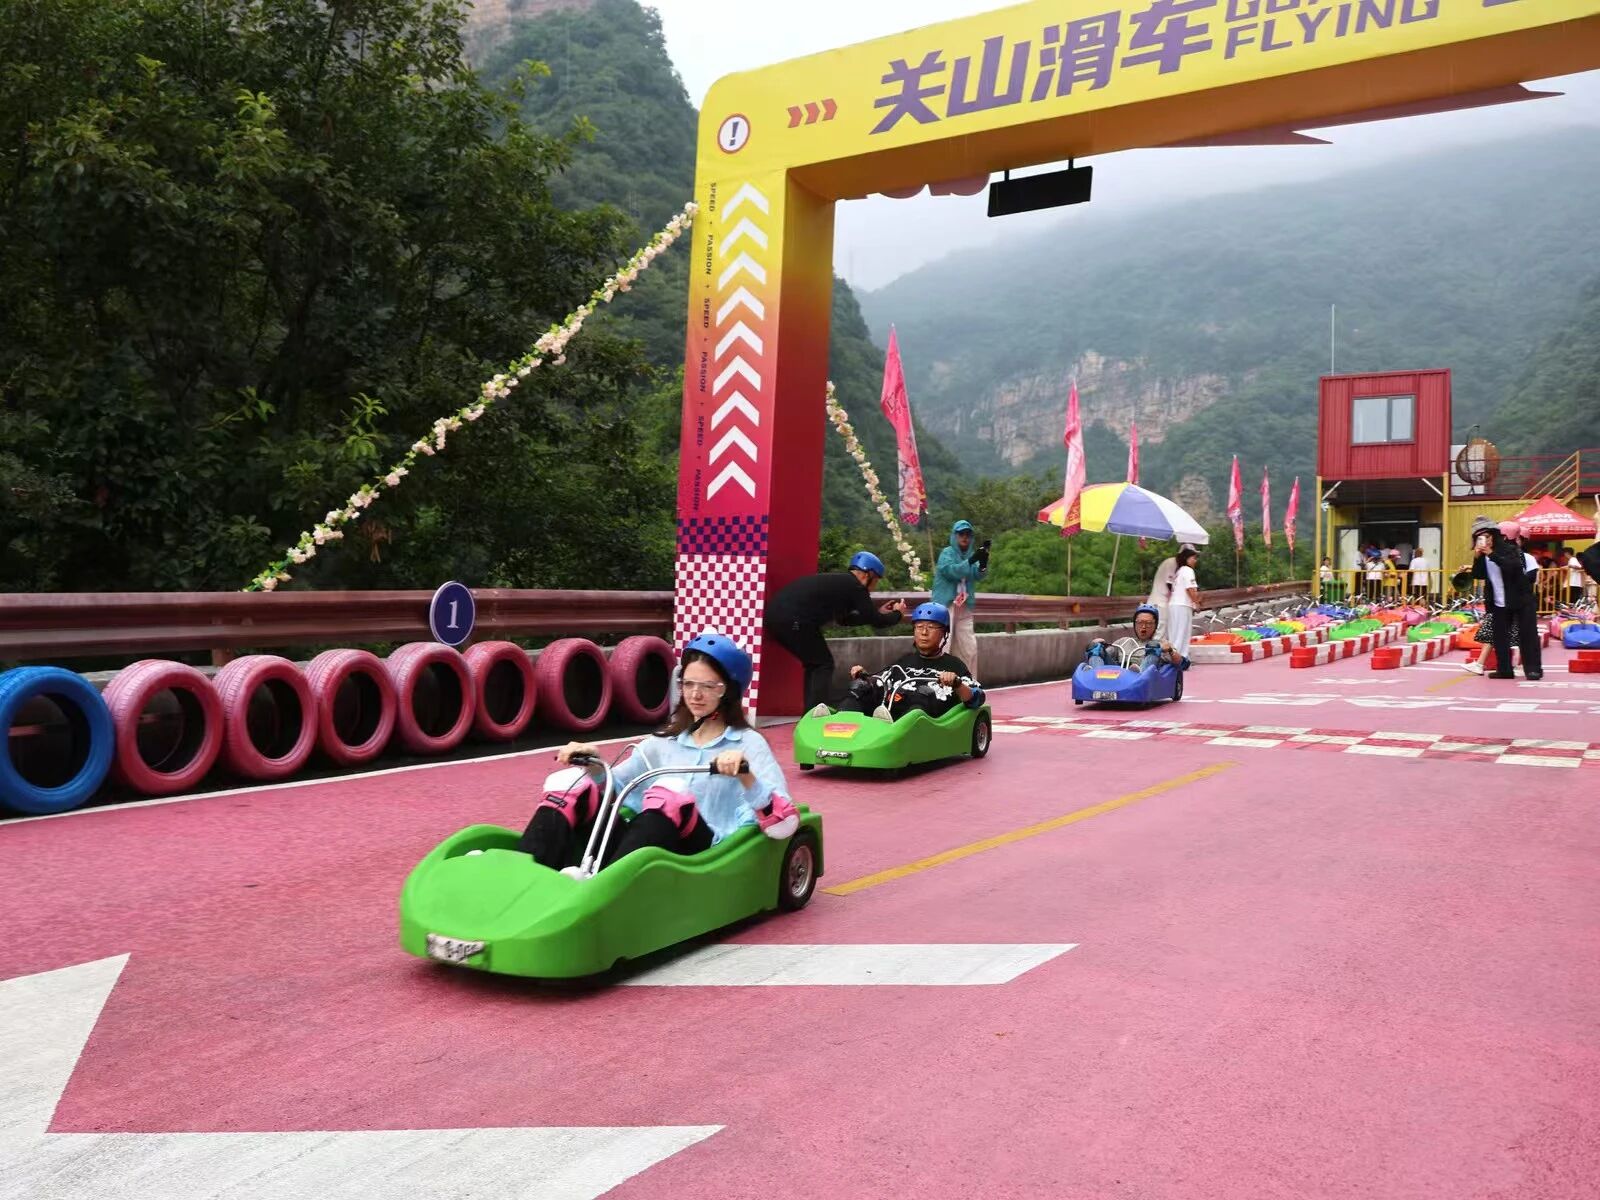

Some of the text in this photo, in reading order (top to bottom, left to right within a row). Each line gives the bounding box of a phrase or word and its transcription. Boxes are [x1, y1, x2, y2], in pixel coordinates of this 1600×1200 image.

[1224, 0, 1440, 59] FLYING
[869, 0, 1217, 135] 关山滑车
[708, 182, 717, 212] SPEED
[705, 234, 714, 275] PASSION
[703, 298, 711, 328] SPEED
[699, 351, 708, 393] PASSION
[446, 600, 459, 629] 1
